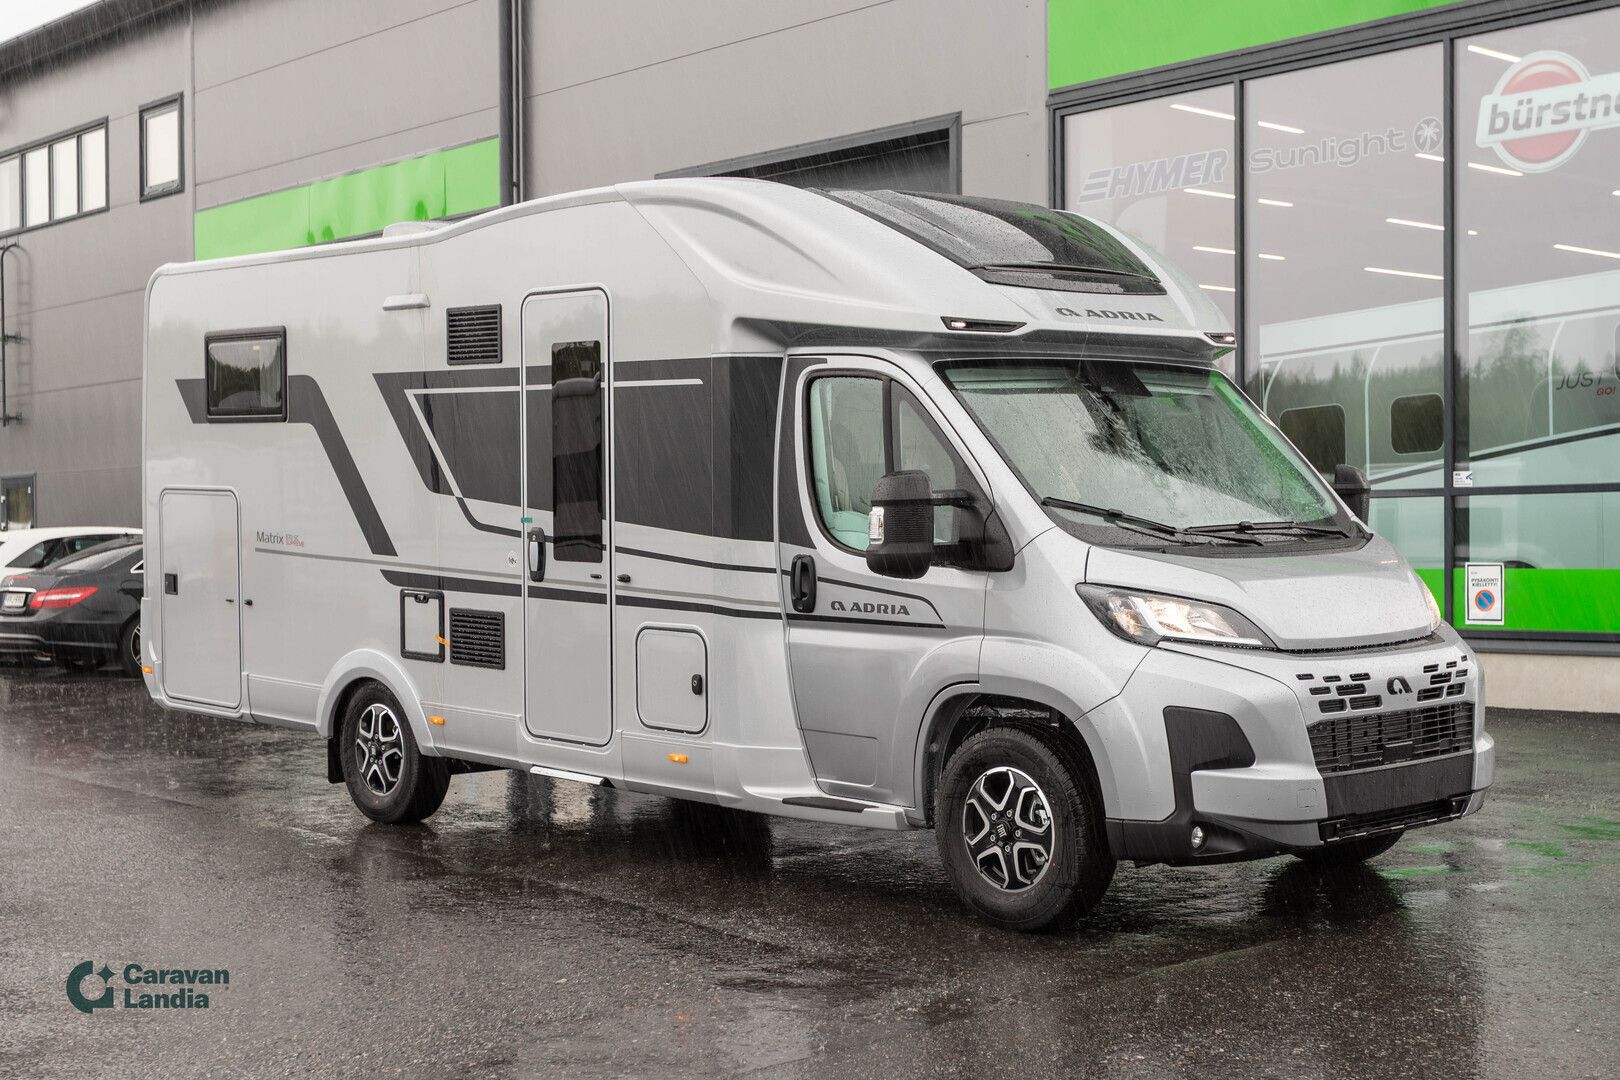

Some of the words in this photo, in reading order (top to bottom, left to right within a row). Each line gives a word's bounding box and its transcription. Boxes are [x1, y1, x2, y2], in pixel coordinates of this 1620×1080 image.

[1488, 91, 1620, 135] bürstn
[1250, 127, 1406, 172] Sunlight
[1104, 149, 1228, 200] HYMER
[1085, 309, 1164, 322] ADRIA
[256, 531, 284, 545] Matrix
[850, 601, 911, 616] ADRIA
